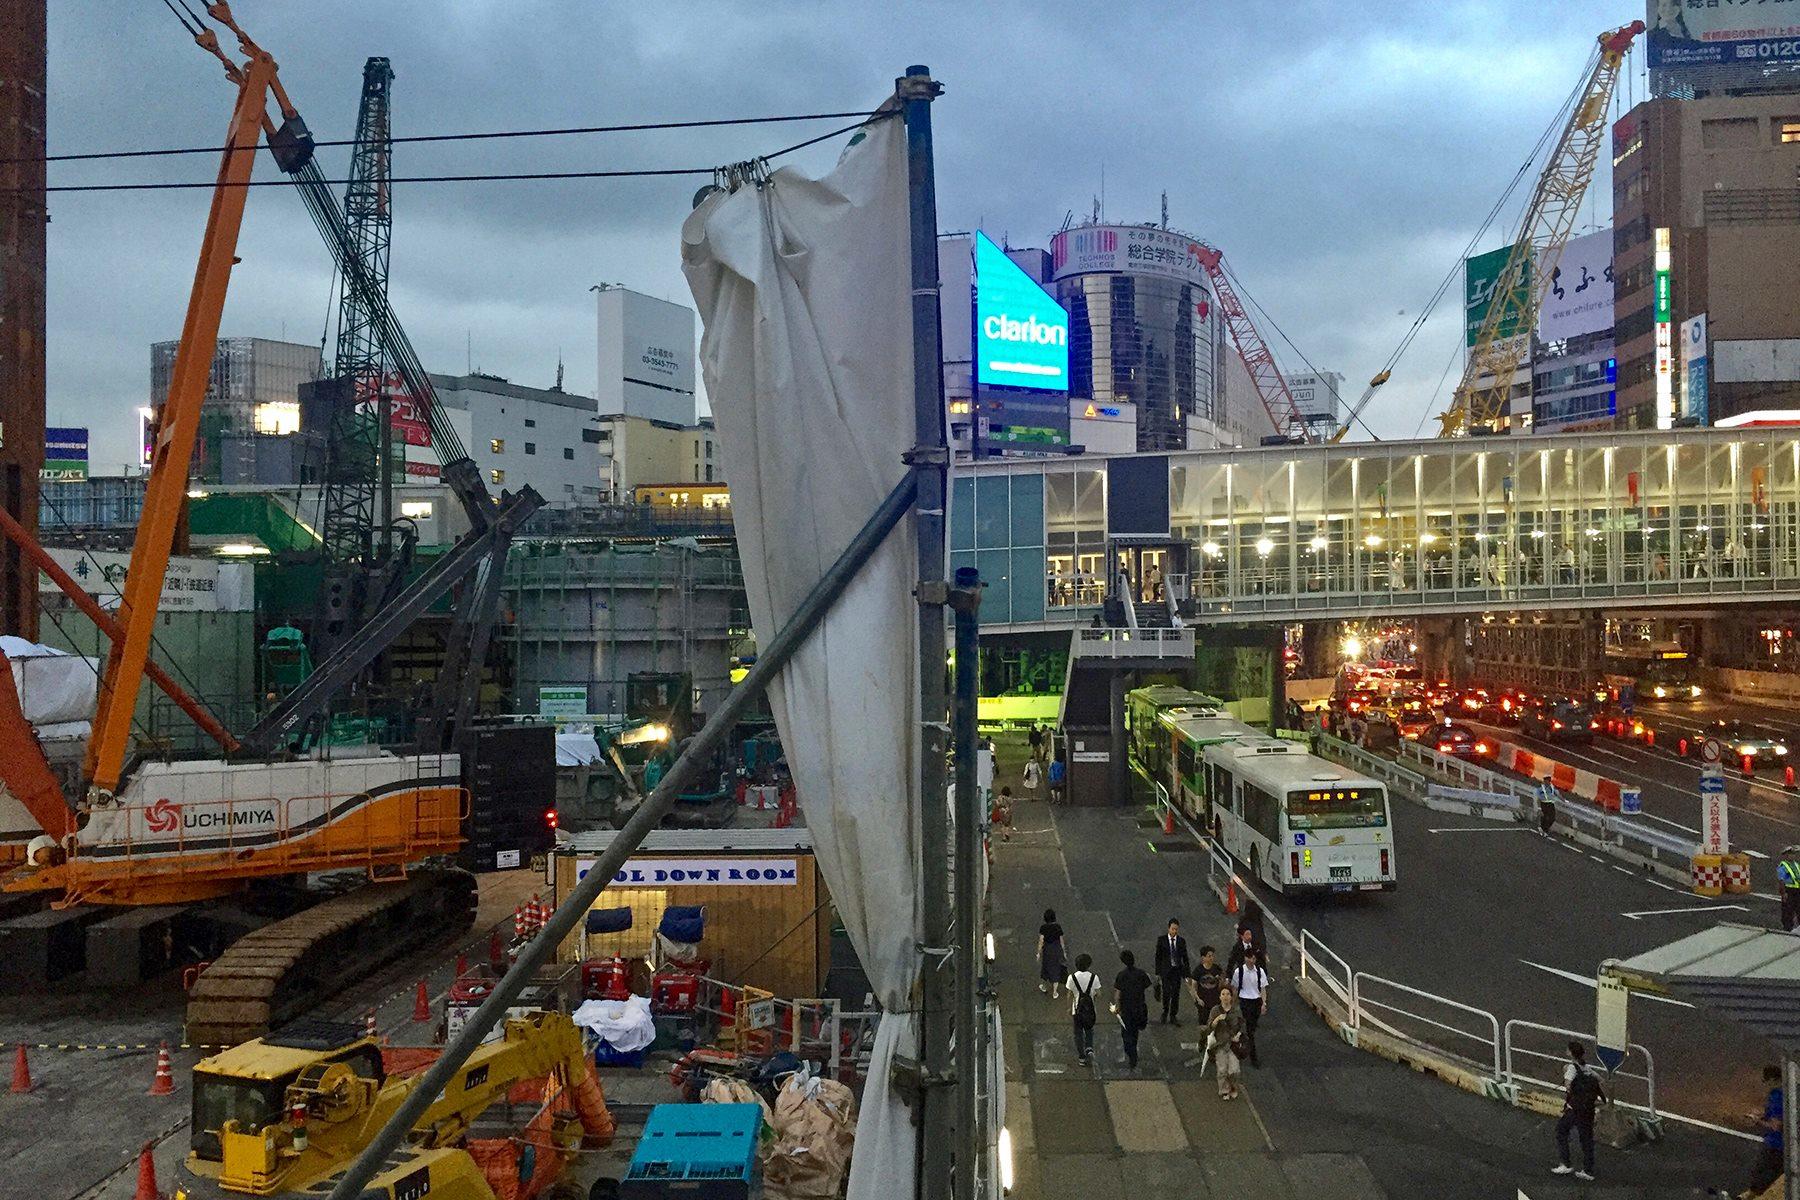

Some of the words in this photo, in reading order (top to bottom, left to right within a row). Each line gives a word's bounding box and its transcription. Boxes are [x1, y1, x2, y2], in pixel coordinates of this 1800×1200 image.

[1079, 253, 1116, 262] TECHNOS
[983, 313, 1067, 346] Clarion
[184, 808, 275, 829] UCHIMIYA
[579, 869, 645, 882] COL
[654, 869, 720, 882] DOWN
[728, 868, 795, 880] ROOM
